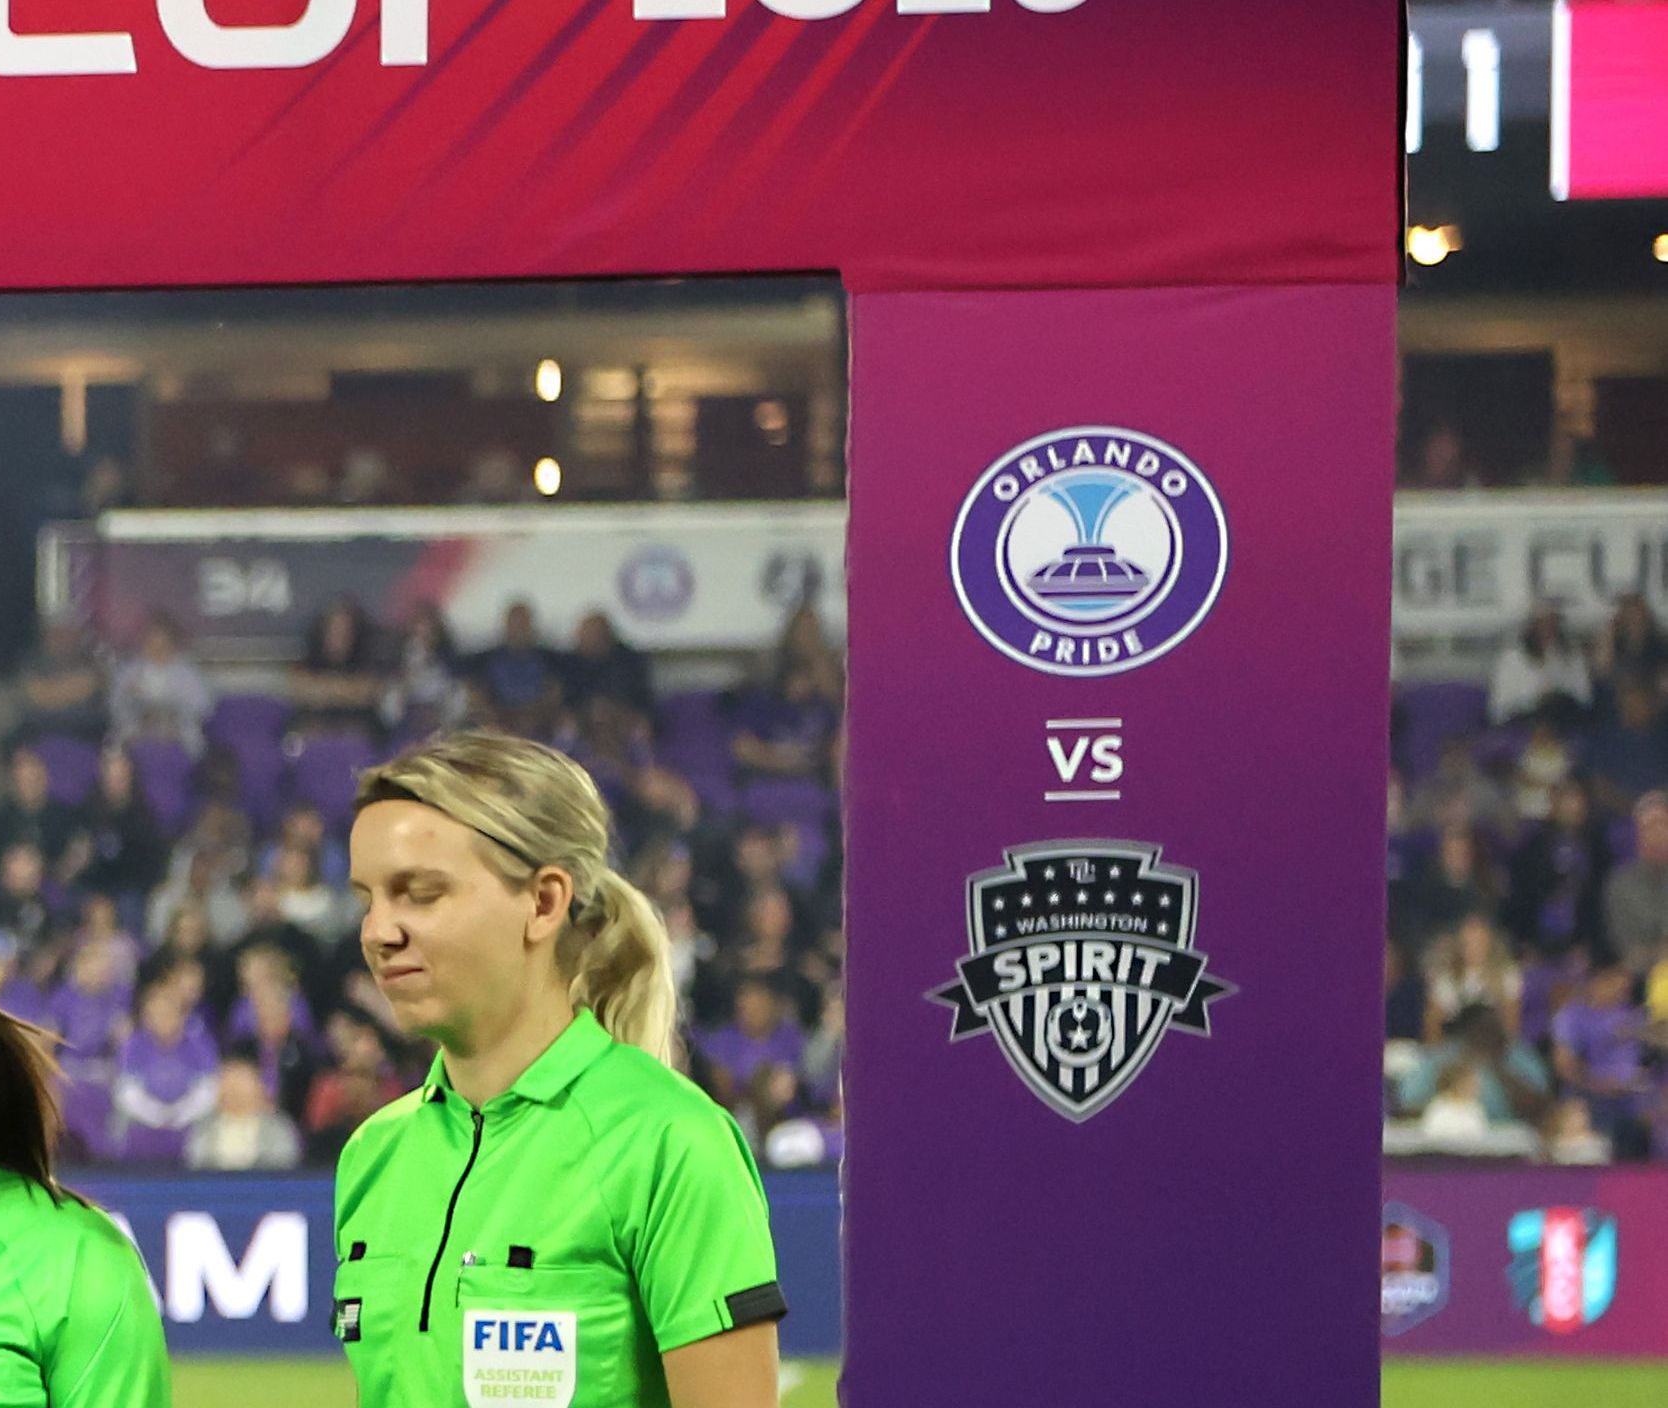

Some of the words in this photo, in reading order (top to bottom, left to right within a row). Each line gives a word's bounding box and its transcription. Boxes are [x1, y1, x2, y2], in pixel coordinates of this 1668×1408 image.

[992, 438, 1189, 502] ORLANDO
[1524, 526, 1668, 610] CU
[1028, 628, 1145, 666] PRIDE
[1046, 734, 1125, 783] VS
[1016, 913, 1149, 935] WASHINGTON
[992, 939, 1171, 991] SPIRIT
[473, 1319, 565, 1353] FIFA
[473, 1367, 564, 1383] ASSISTANT
[480, 1383, 557, 1399] REFEREE
